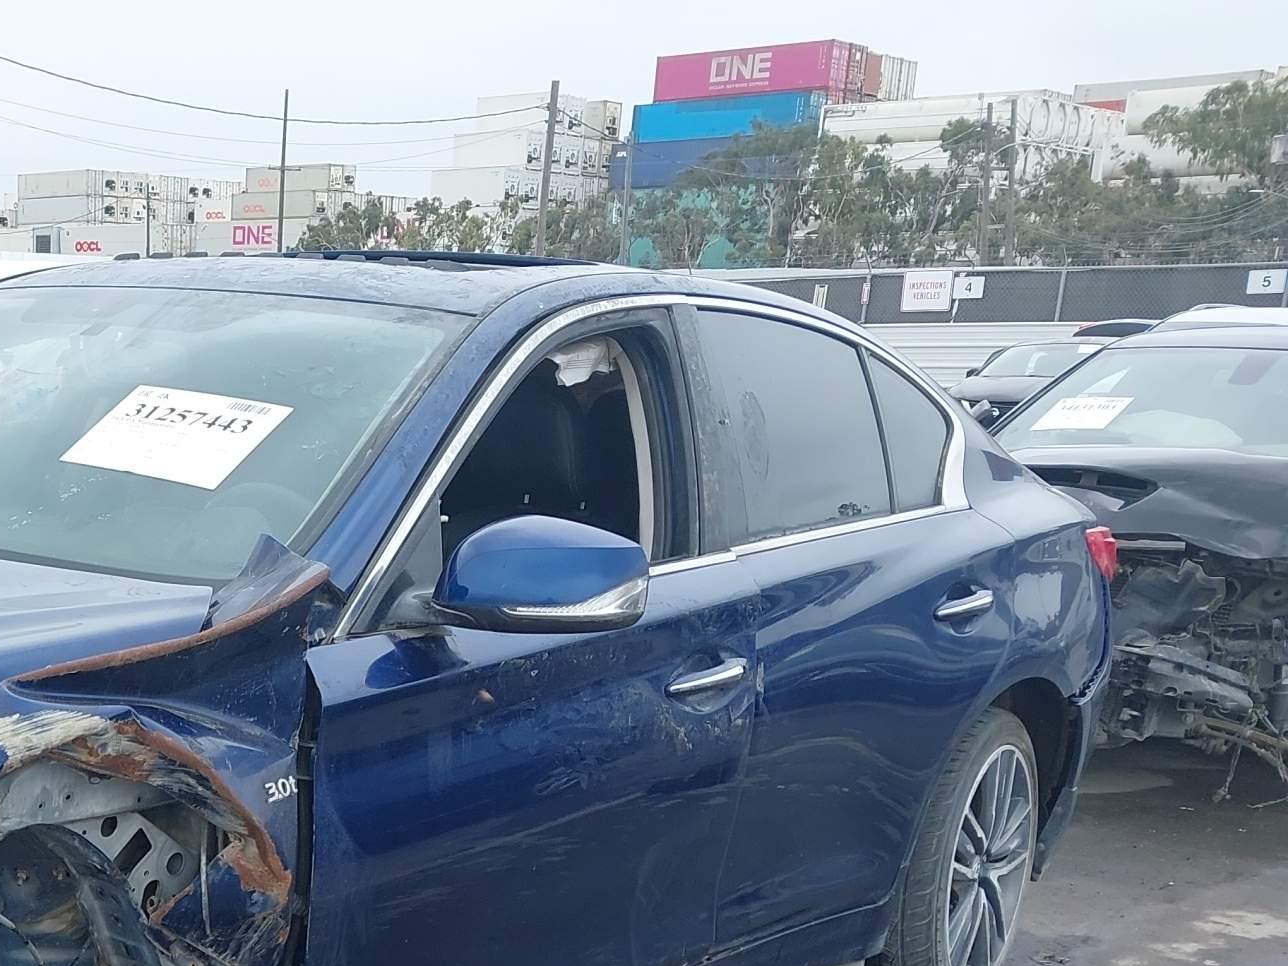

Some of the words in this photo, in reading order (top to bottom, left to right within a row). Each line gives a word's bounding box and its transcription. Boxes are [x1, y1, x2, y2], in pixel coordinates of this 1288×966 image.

[709, 51, 772, 83] ONE
[205, 212, 226, 220] OOCL
[232, 225, 273, 246] ONE
[74, 241, 102, 252] OOCL
[909, 281, 947, 290] INSPECTIONS
[1262, 275, 1272, 288] 5
[964, 282, 972, 293] 4
[913, 291, 941, 300] VEHICLES
[124, 402, 254, 435] 31257443
